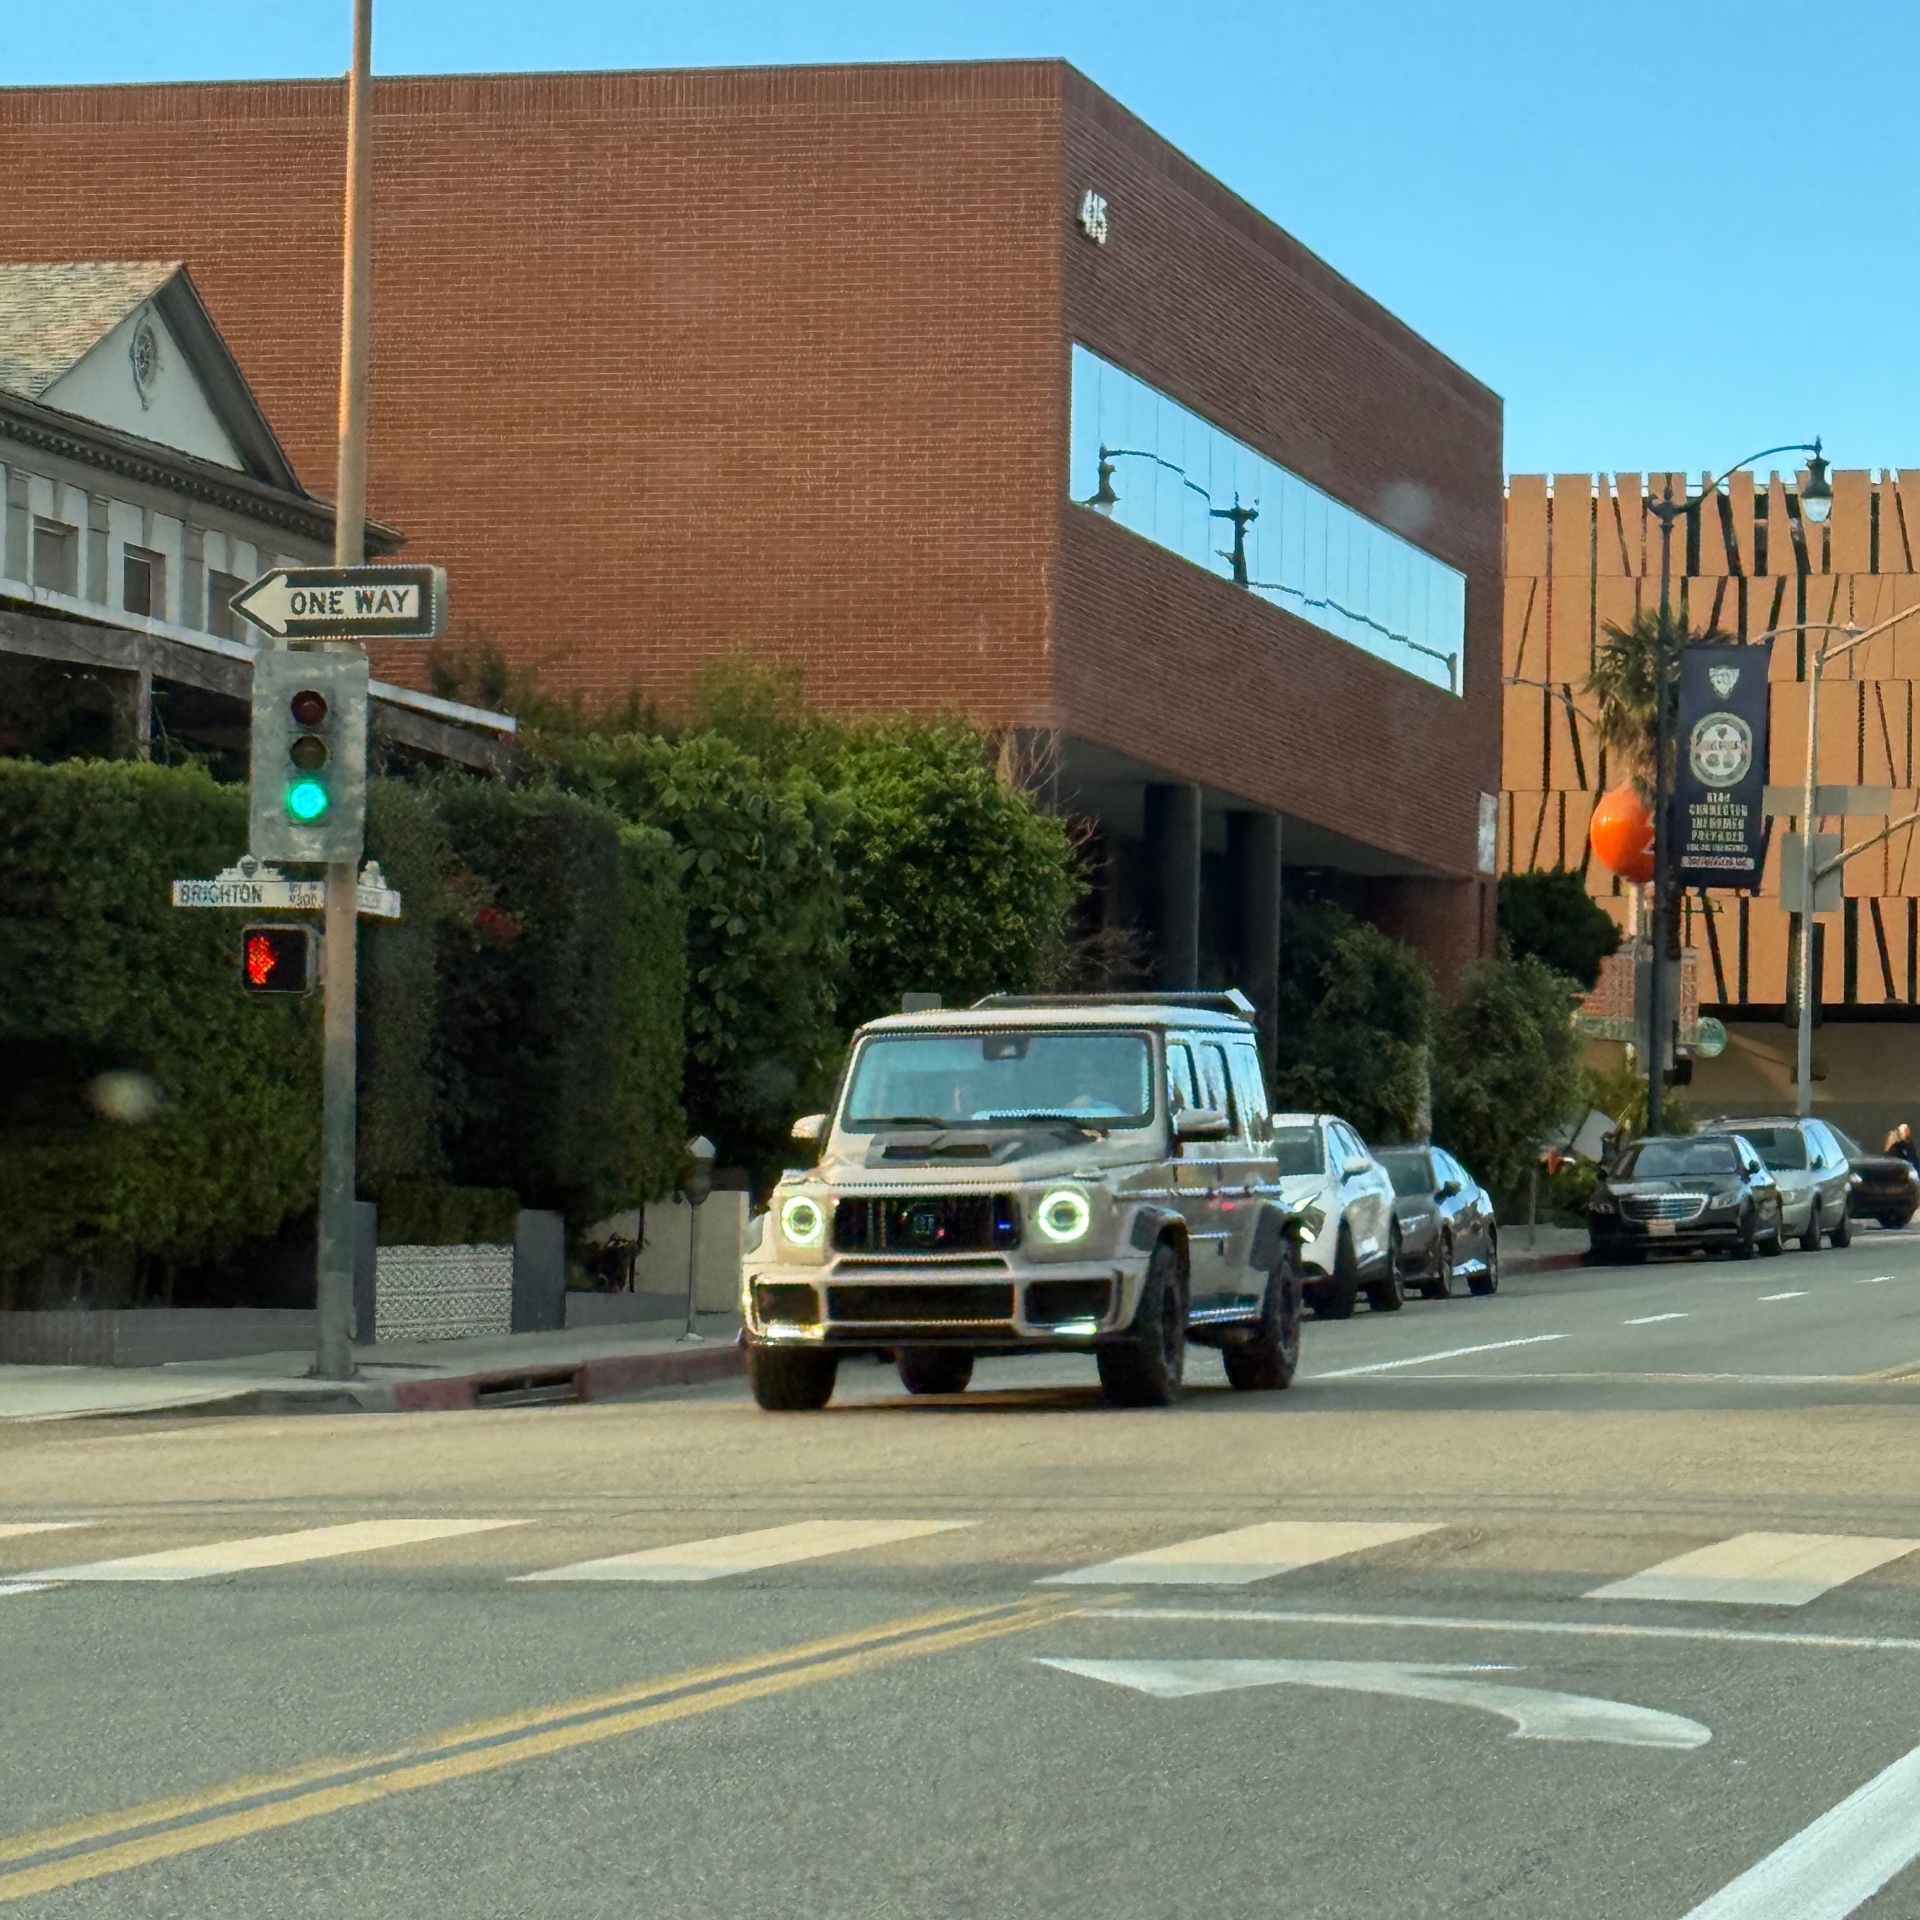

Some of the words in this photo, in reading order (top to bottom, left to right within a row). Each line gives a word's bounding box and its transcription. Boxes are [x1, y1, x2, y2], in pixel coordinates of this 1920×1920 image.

[290, 590, 345, 615] ONE
[355, 588, 410, 614] WAY
[180, 884, 263, 904] BRIGHTON
